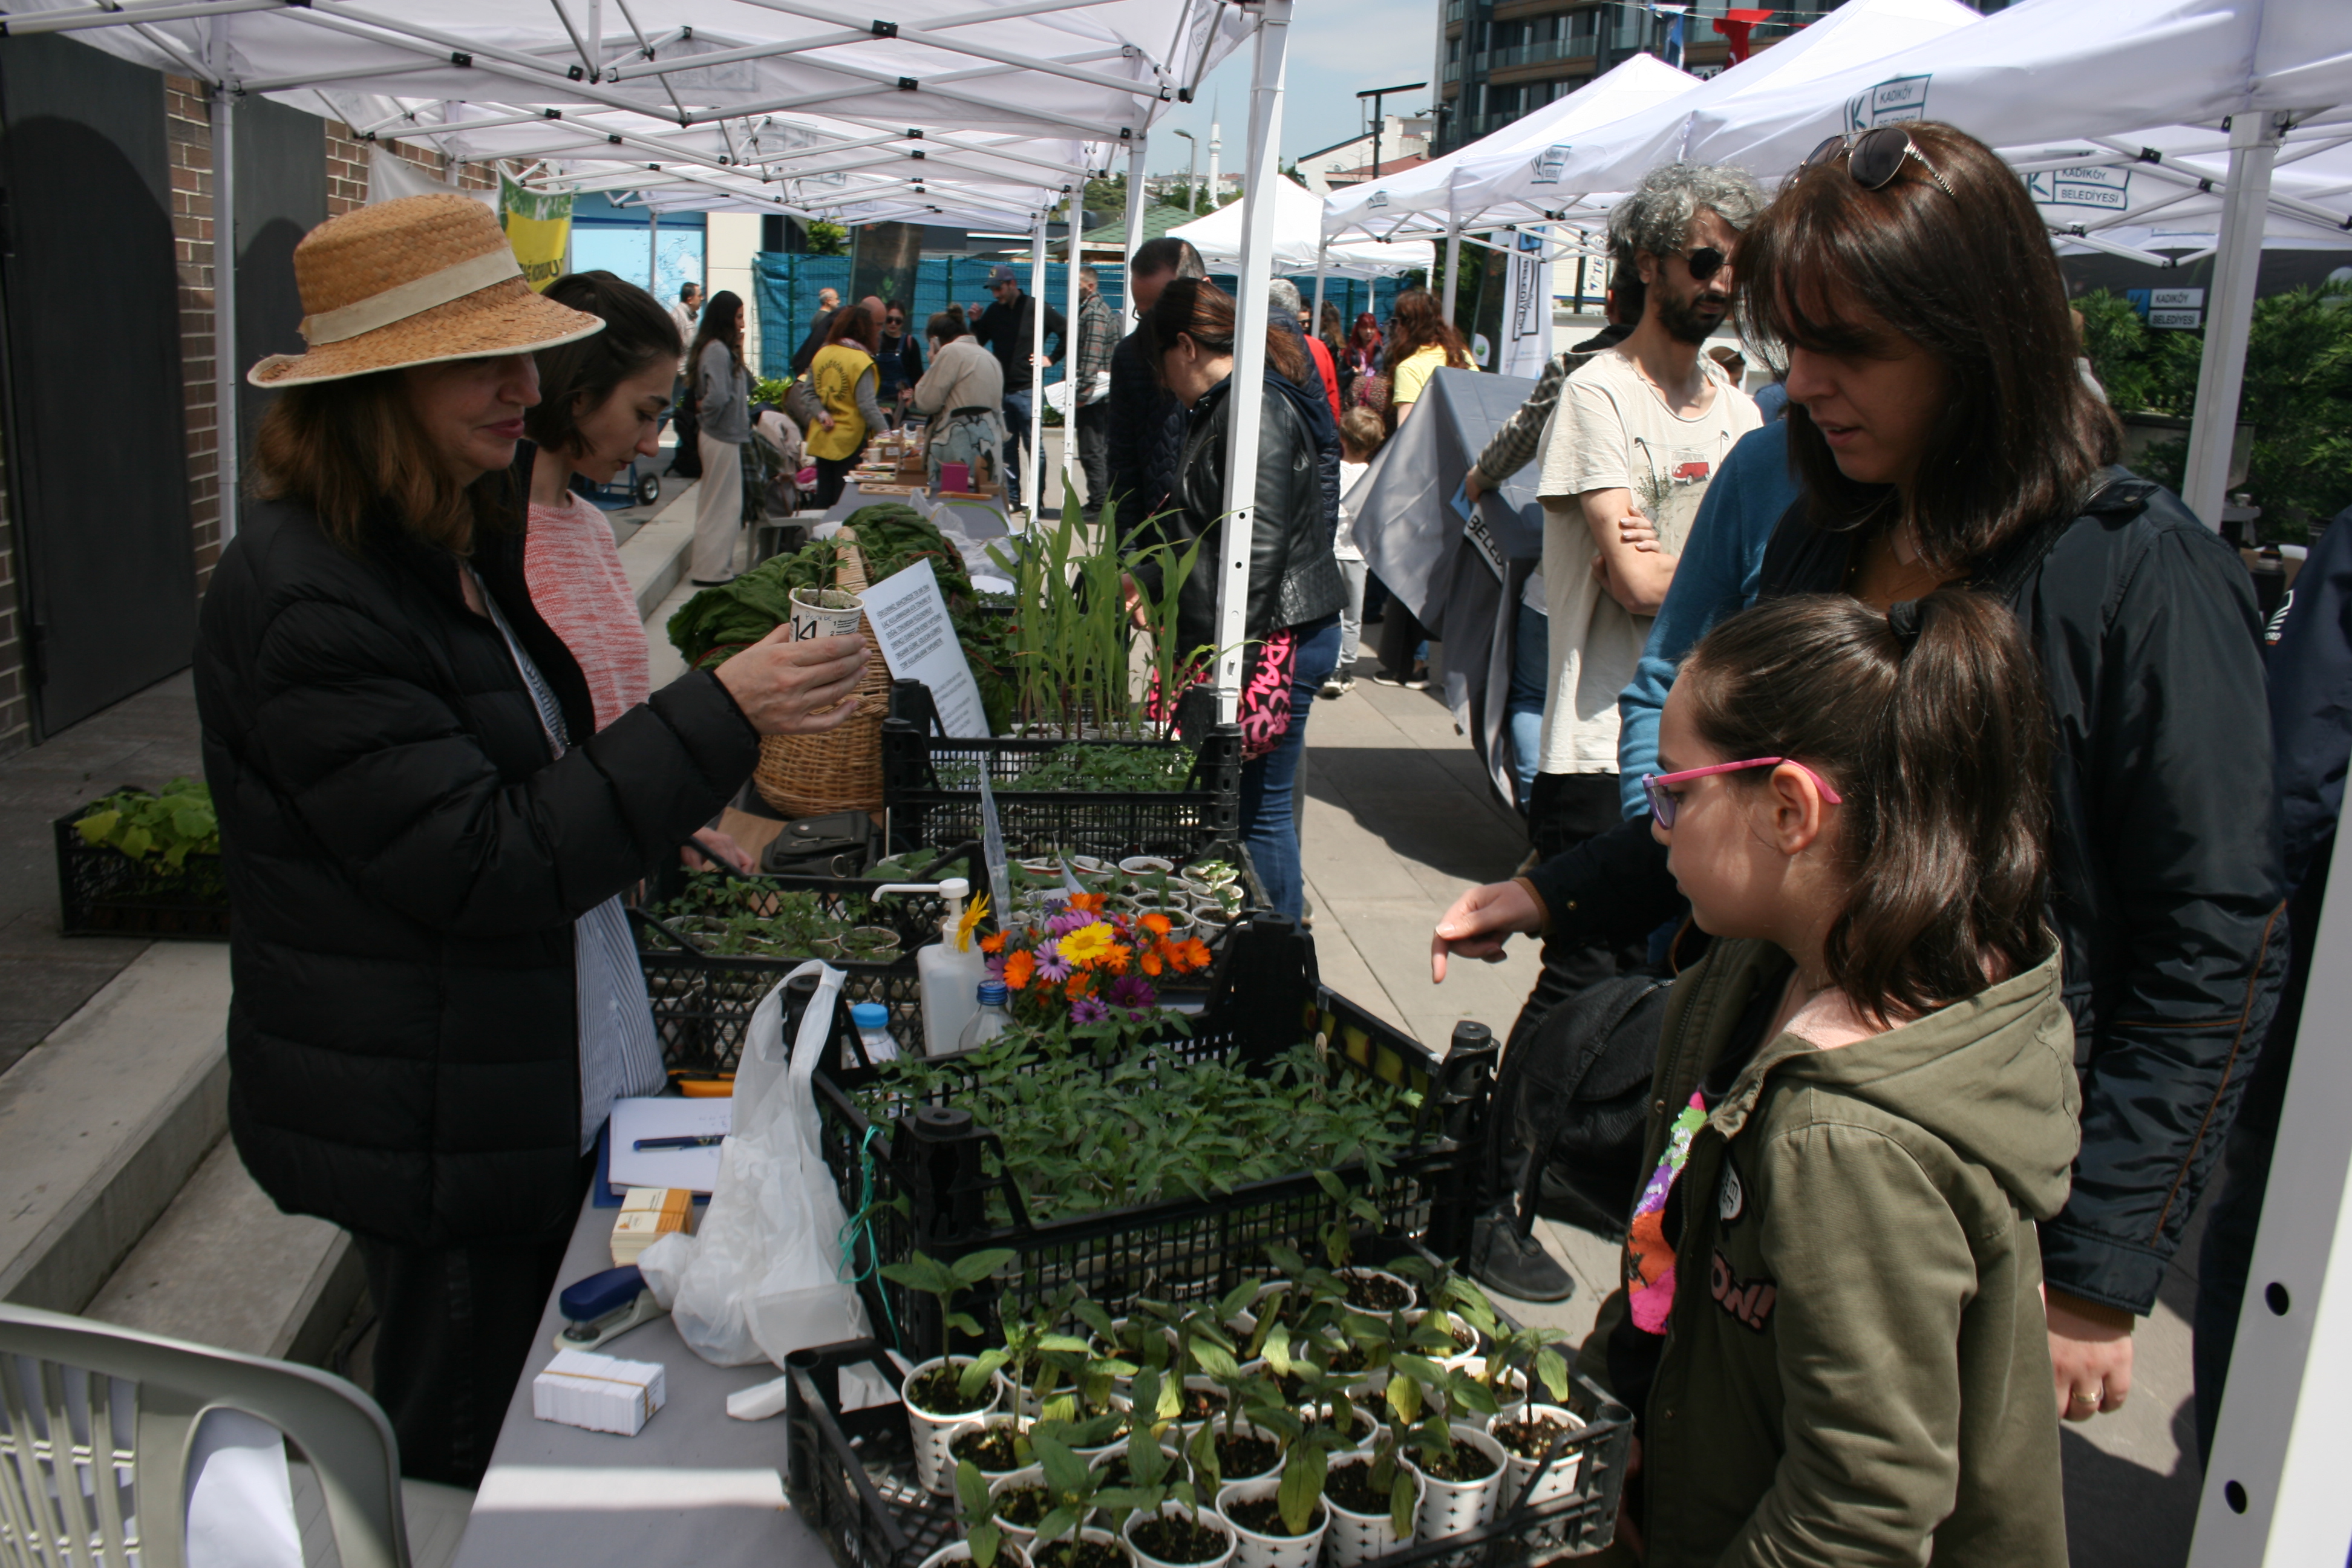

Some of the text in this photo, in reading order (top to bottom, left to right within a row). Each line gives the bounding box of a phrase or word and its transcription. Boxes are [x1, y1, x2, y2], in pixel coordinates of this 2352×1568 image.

[1880, 85, 1913, 103] KADIKÖY
[2062, 168, 2106, 180] KADIKÖY
[2062, 189, 2118, 203] BELEDİYESİ
[2155, 292, 2189, 303] KADIKÖY
[2152, 313, 2195, 325] BELEDİYESİ
